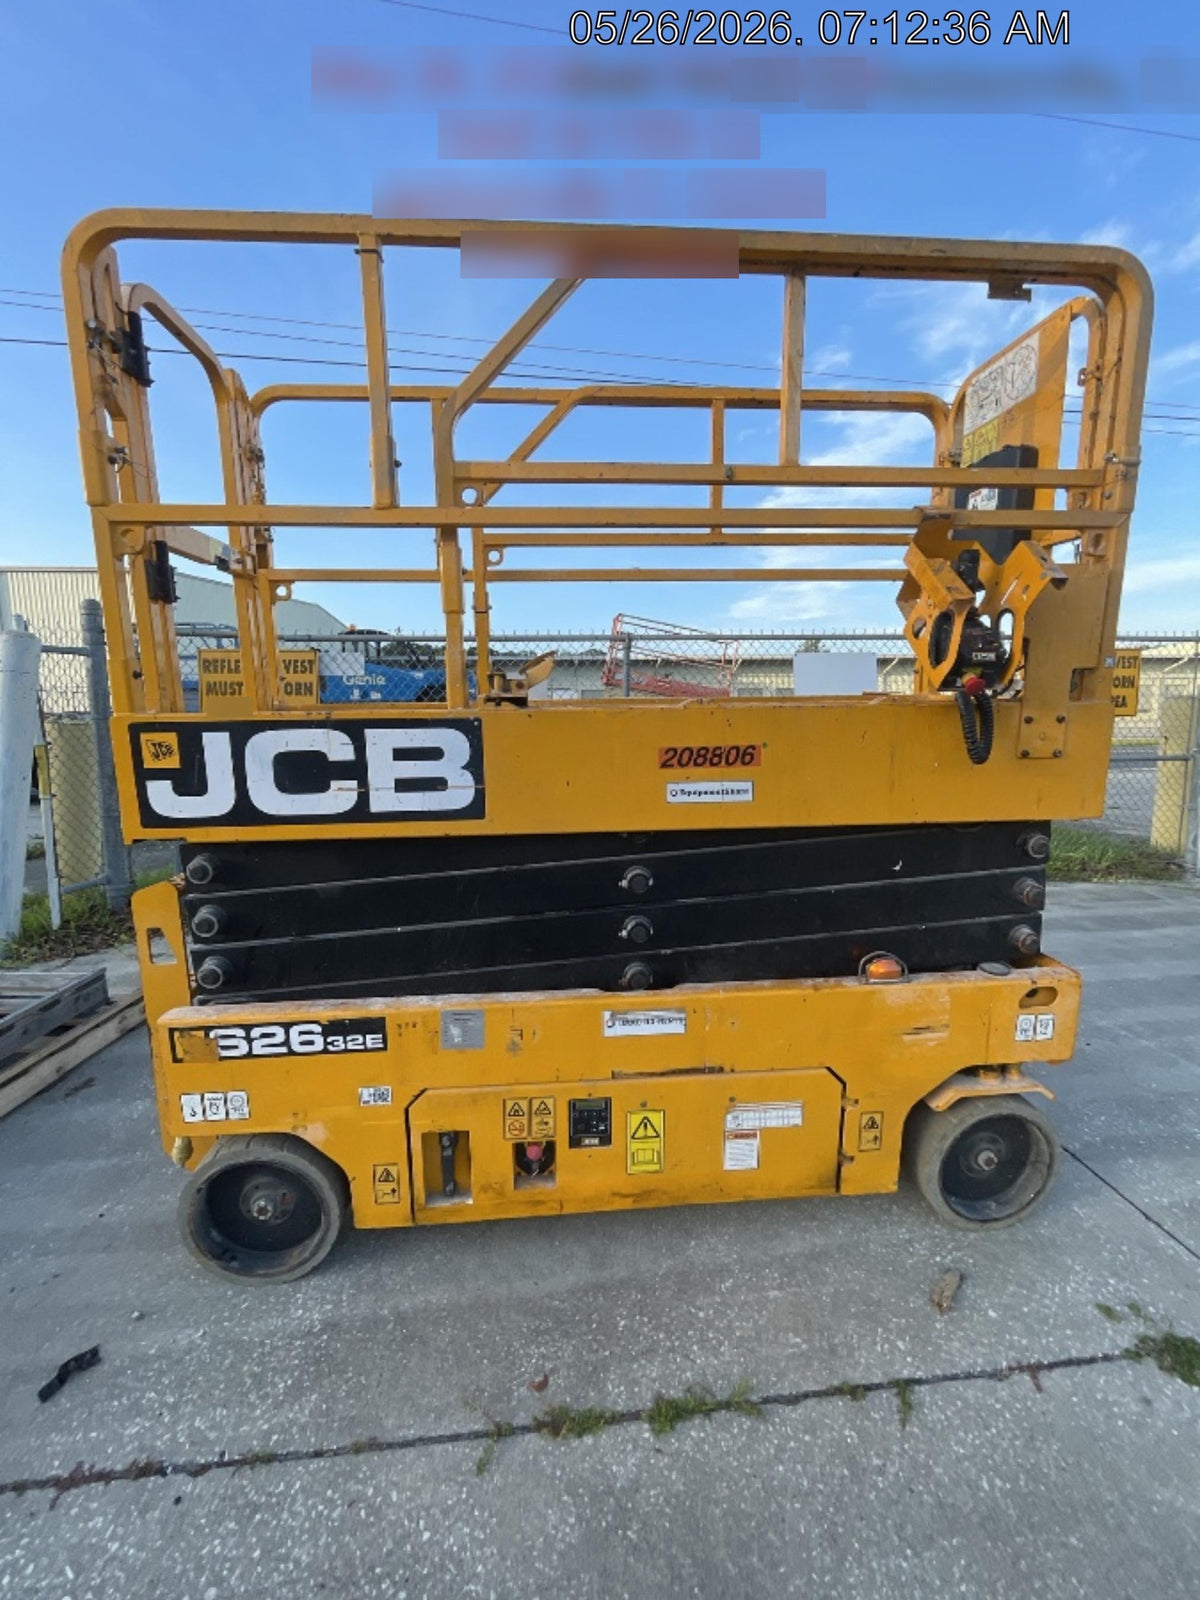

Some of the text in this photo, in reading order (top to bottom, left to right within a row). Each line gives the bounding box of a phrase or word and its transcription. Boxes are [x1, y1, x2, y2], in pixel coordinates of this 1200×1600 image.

[202, 659, 315, 674] REFLE VEST
[205, 682, 313, 696] MUST ORN
[1113, 675, 1135, 688] ORN
[659, 745, 757, 768] 208806
[145, 727, 476, 819] JCB
[209, 1024, 384, 1057] S26 32E
